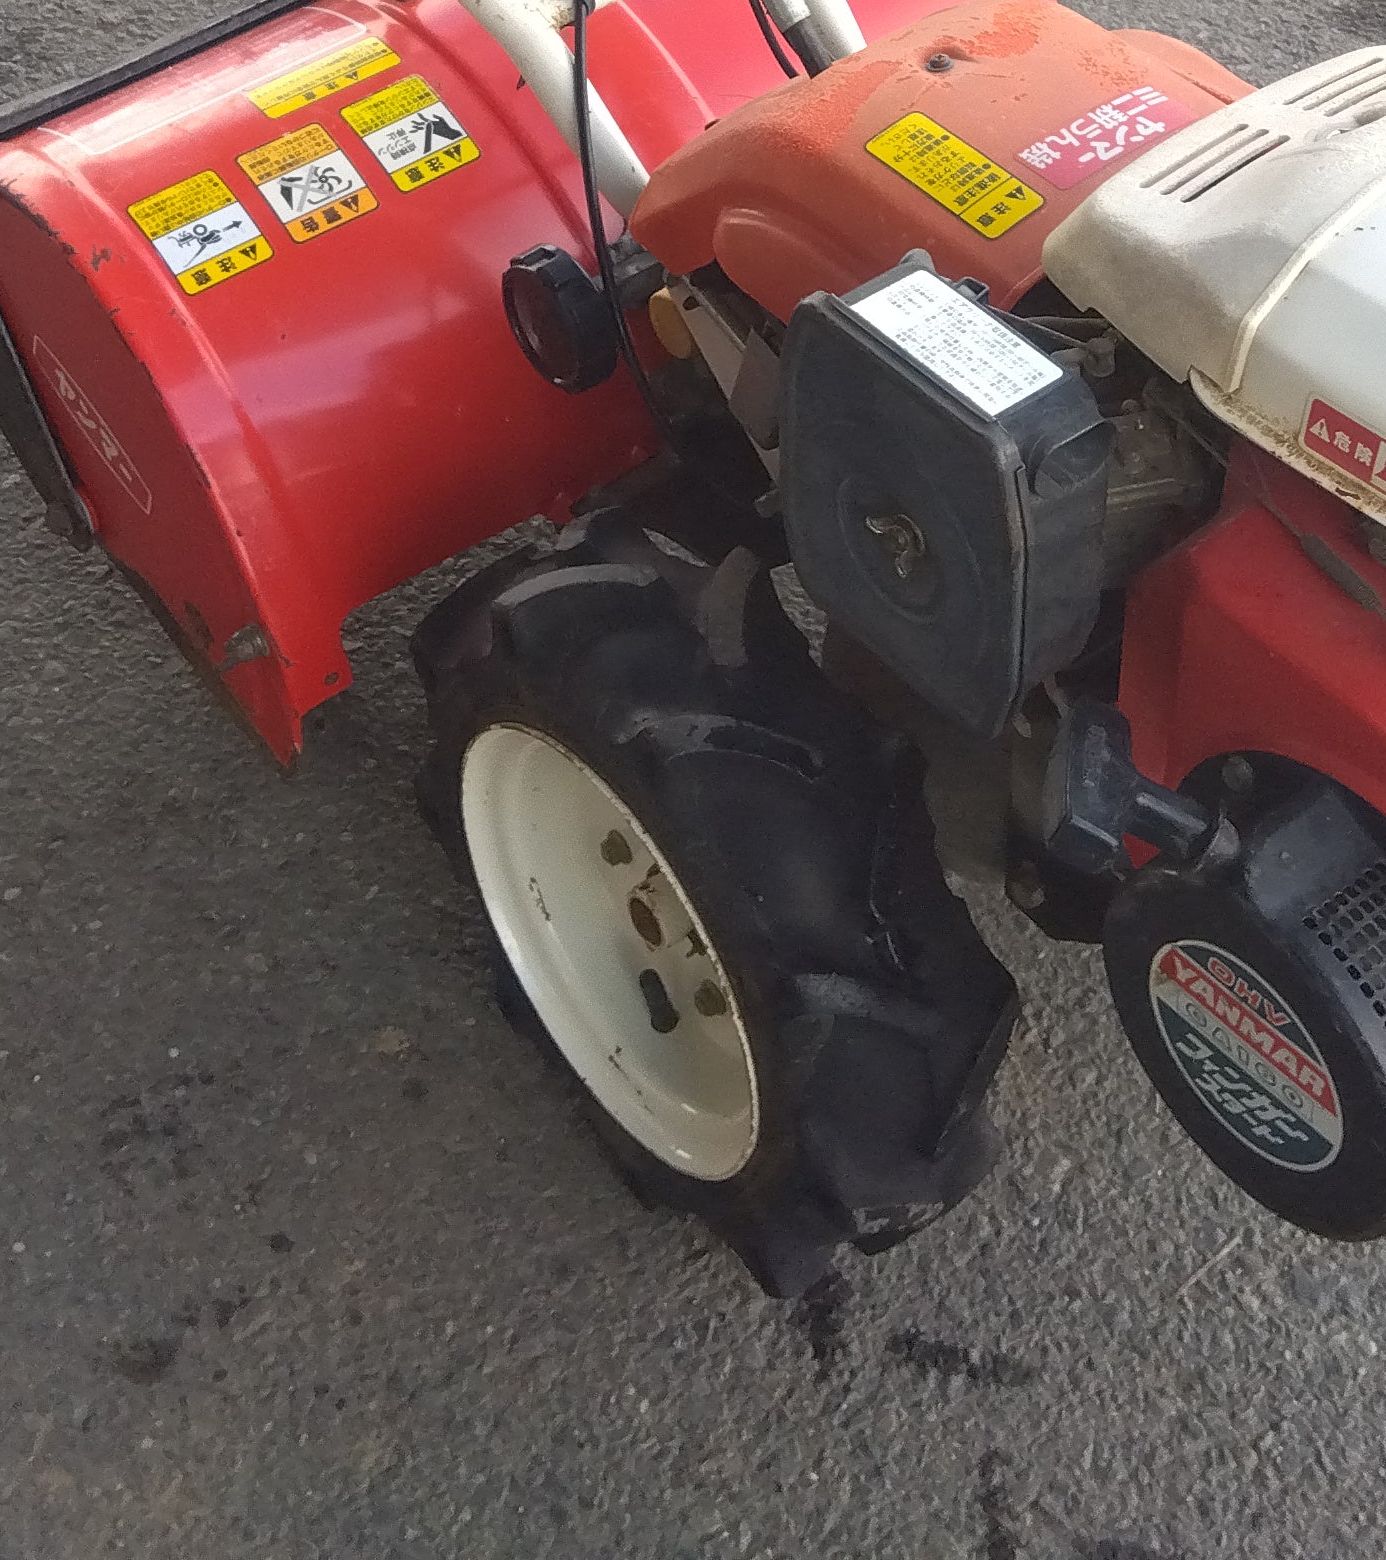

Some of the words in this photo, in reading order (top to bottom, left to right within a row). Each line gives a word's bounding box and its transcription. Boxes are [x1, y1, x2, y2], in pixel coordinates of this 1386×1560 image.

[1018, 86, 1169, 169] ミニ耕うん機
[1078, 116, 1165, 163] ヤンマー
[405, 156, 445, 183] 注意
[300, 206, 343, 233] 警告
[976, 202, 1011, 227] 注意
[191, 256, 237, 286] 注意
[1333, 431, 1373, 466] 危険
[1208, 956, 1291, 1027] OHV
[1175, 957, 1326, 1096] YANMAR
